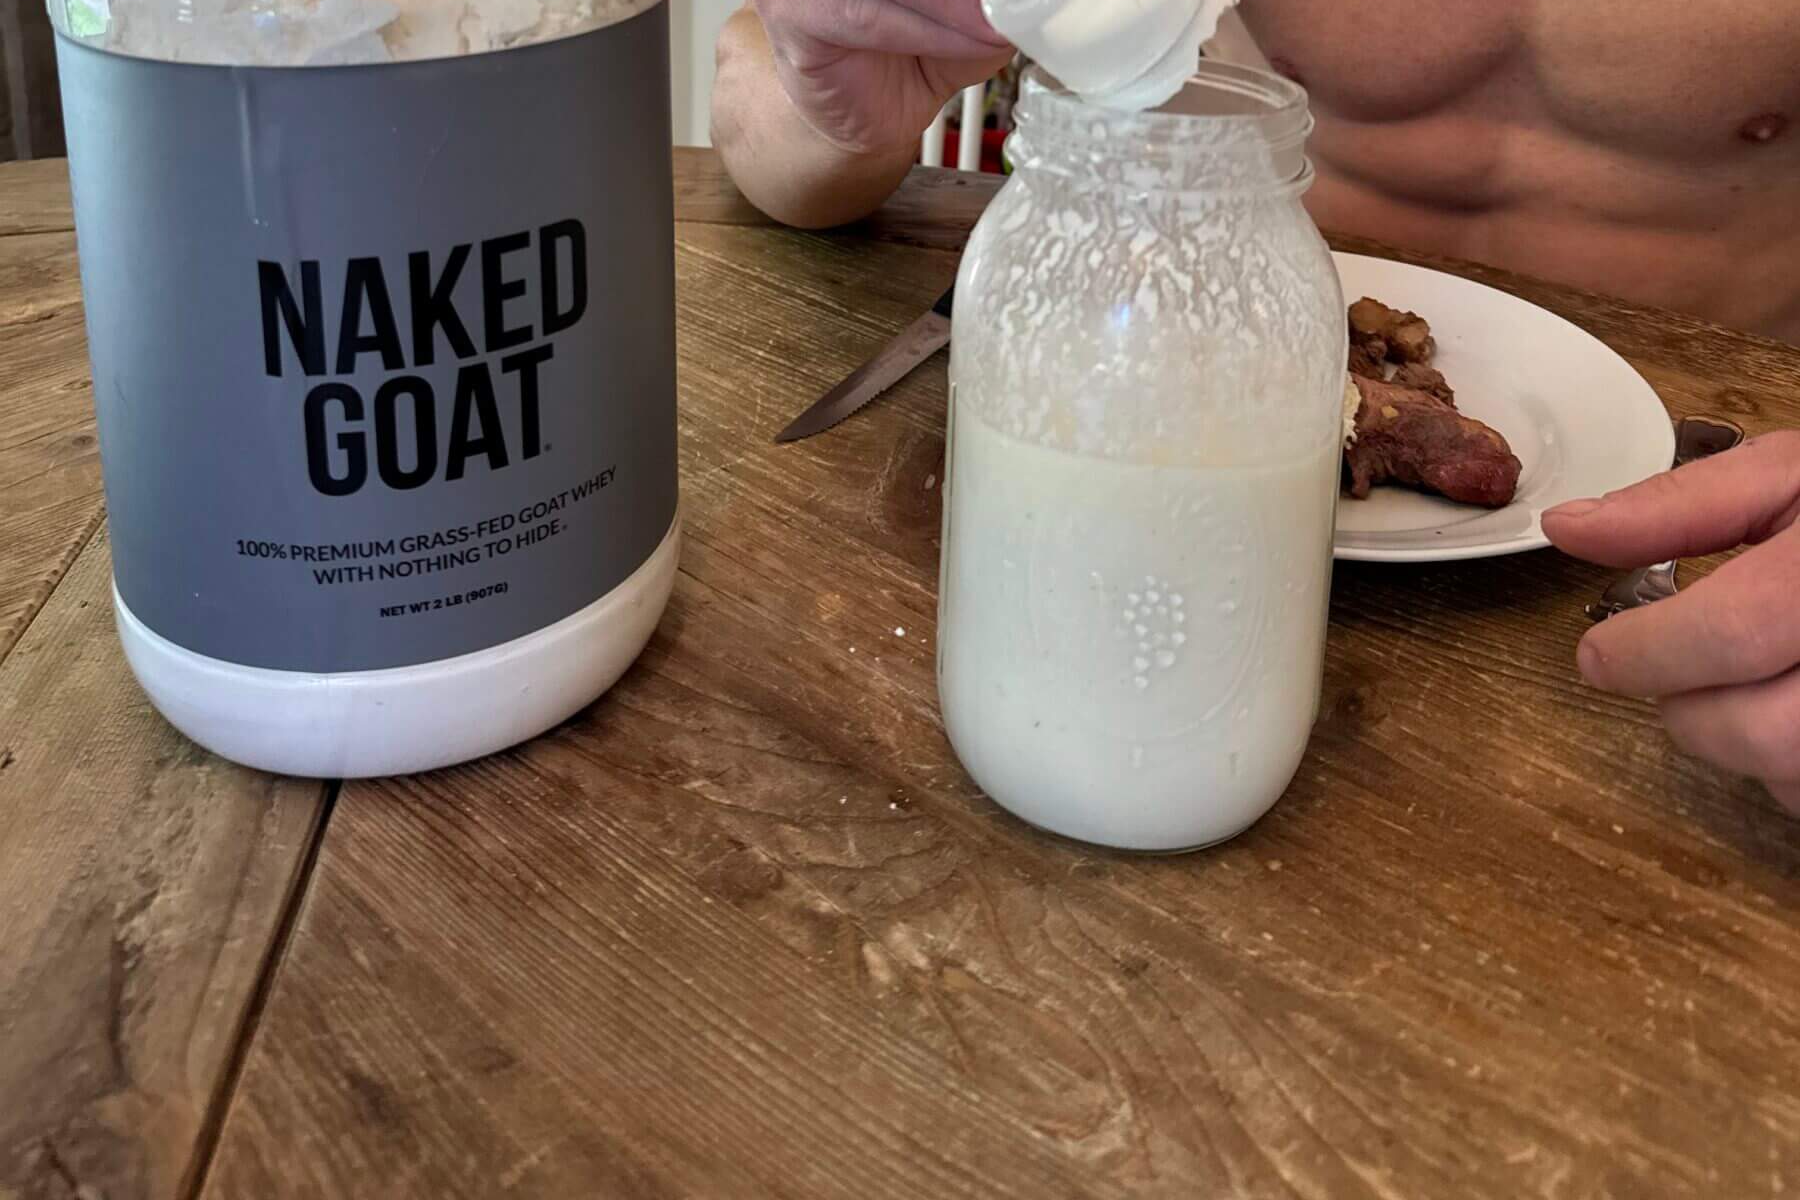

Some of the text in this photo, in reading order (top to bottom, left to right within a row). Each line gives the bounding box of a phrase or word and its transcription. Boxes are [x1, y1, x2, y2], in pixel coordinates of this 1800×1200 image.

[257, 218, 588, 378] NAKED
[236, 466, 618, 563] 100% PREMIUM GRASS-FED GOAT WHEY
[313, 567, 375, 585] WITH
[379, 549, 481, 579] NOTHING
[483, 538, 512, 560] TO
[379, 581, 509, 618] NET WT 2 LB (907G)
